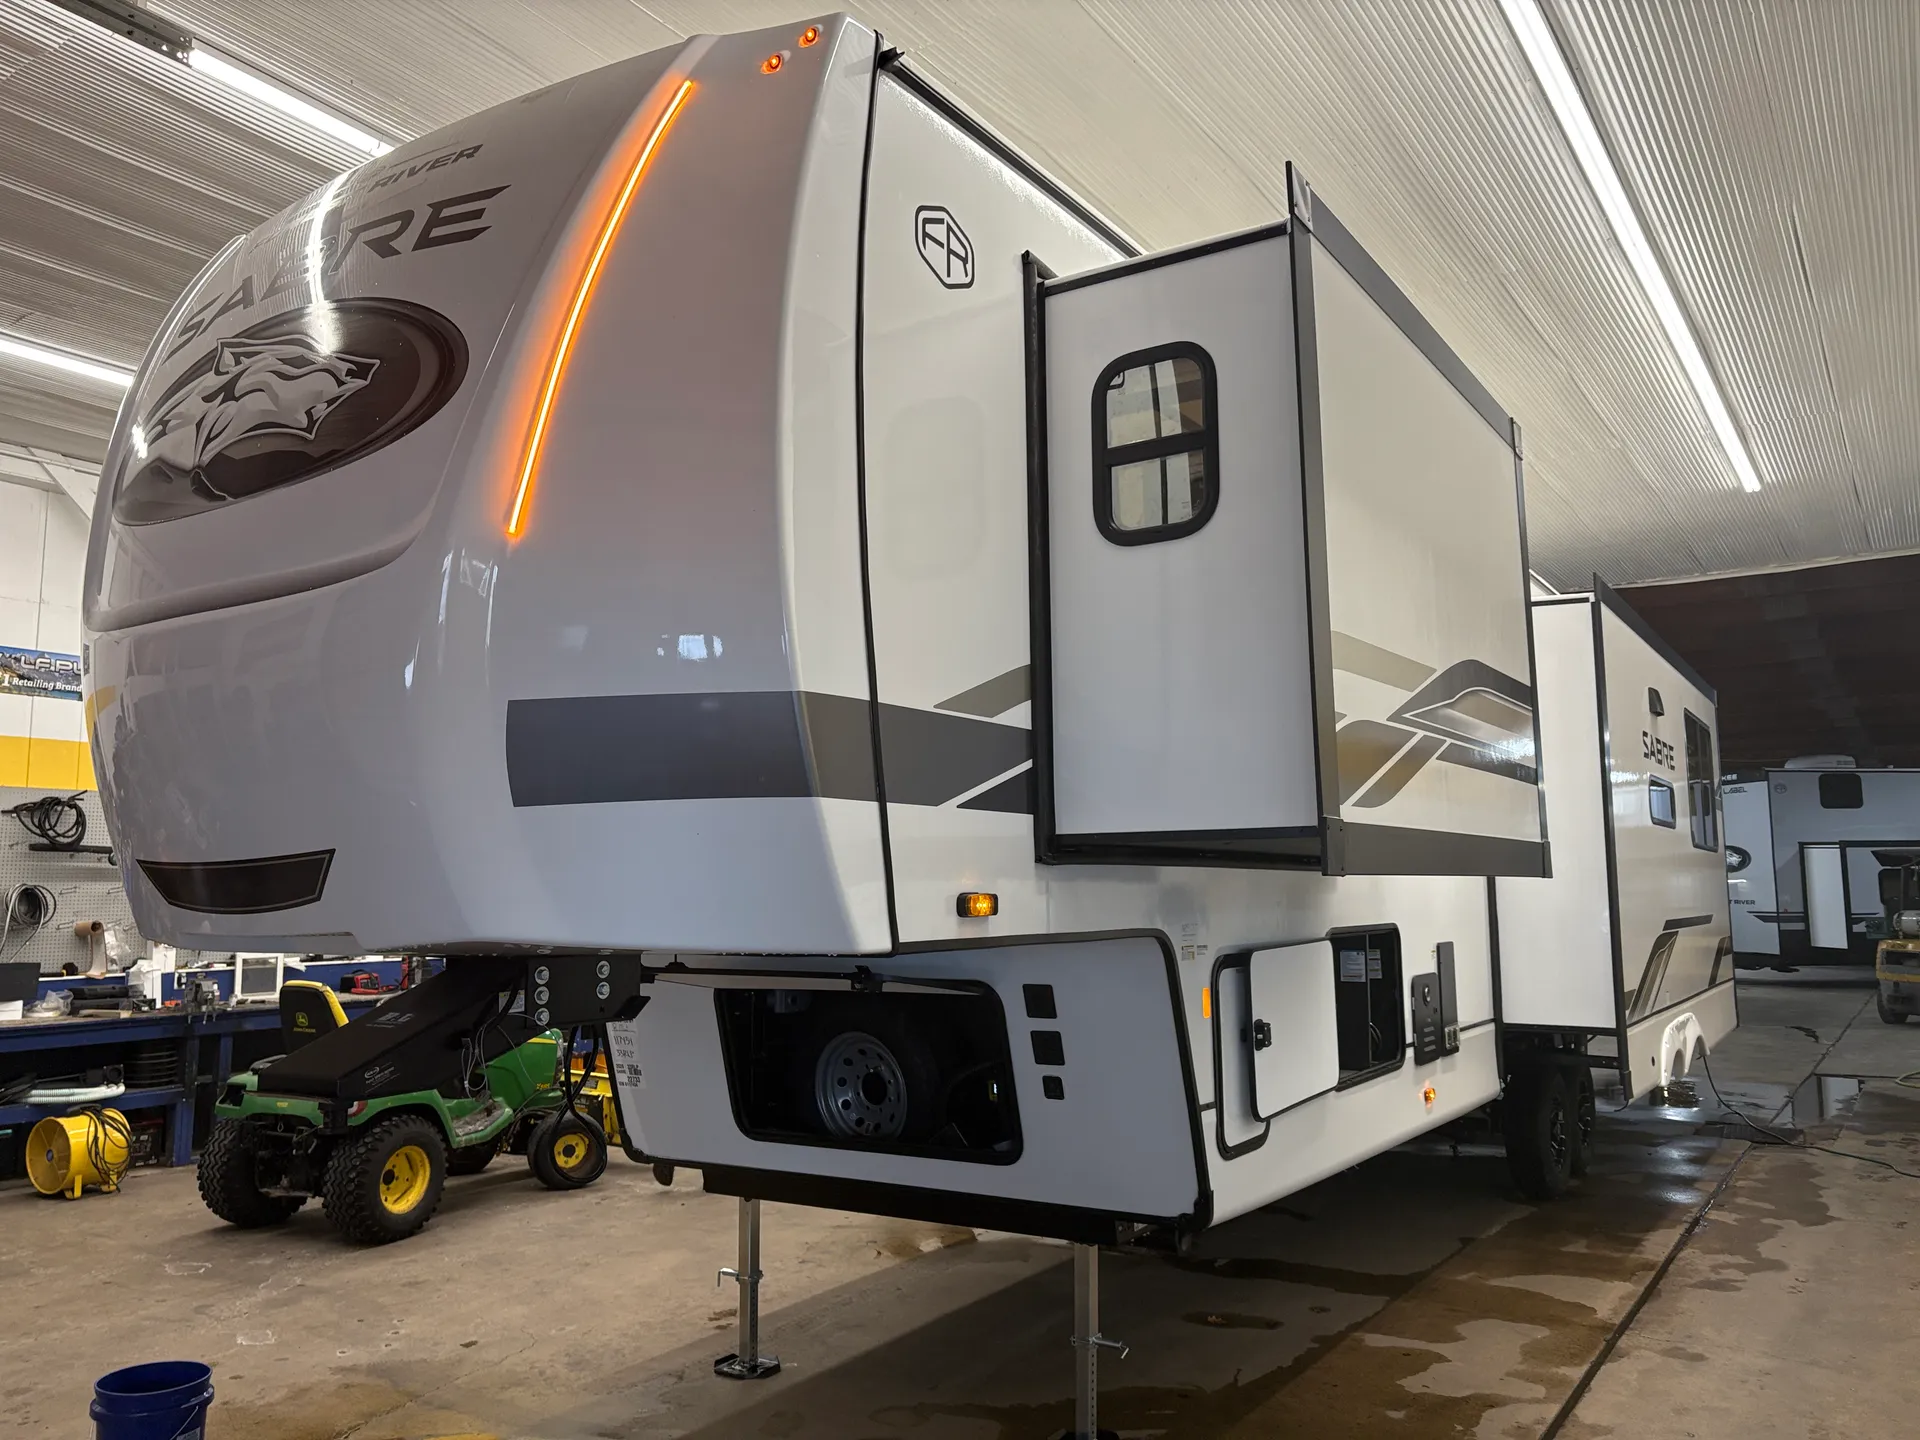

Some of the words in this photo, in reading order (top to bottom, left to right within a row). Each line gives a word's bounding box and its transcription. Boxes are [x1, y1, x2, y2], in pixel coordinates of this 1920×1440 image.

[367, 143, 484, 193] RIVER
[160, 184, 512, 366] SABRE
[12, 677, 55, 691] Retailing
[55, 681, 82, 692] Brand
[1642, 730, 1675, 771] SABRE
[1723, 786, 1748, 795] LABEL
